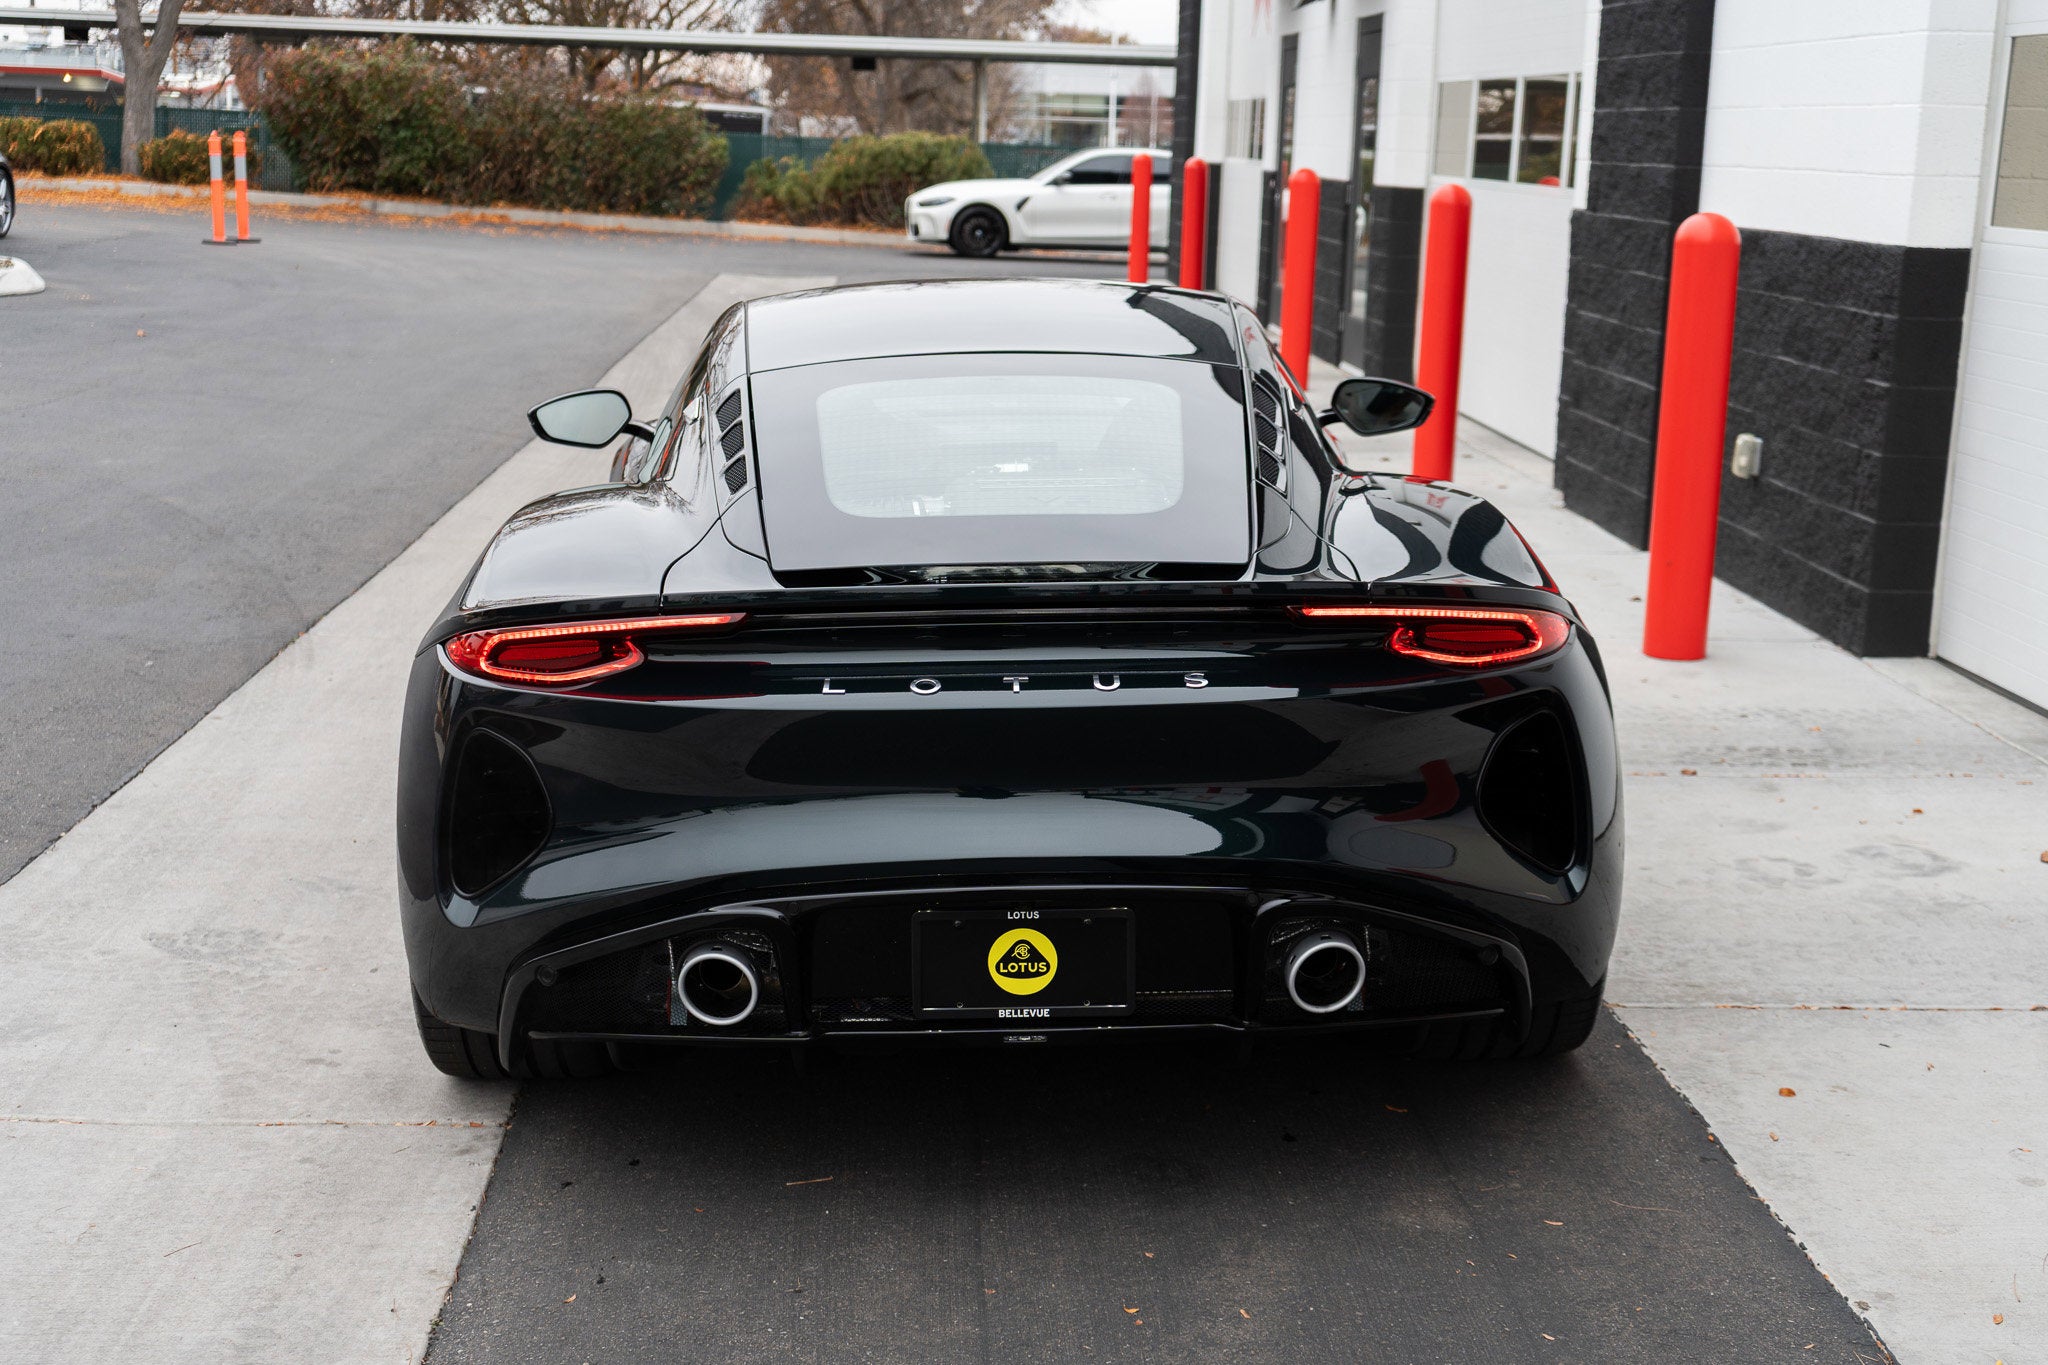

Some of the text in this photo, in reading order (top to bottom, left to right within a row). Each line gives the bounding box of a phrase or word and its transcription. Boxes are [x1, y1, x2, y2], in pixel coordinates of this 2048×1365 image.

[822, 673, 1209, 694] LOTUS
[1007, 911, 1040, 919] LOTUS
[999, 962, 1047, 973] LOTUS
[998, 1009, 1050, 1018] BELLEVUE
